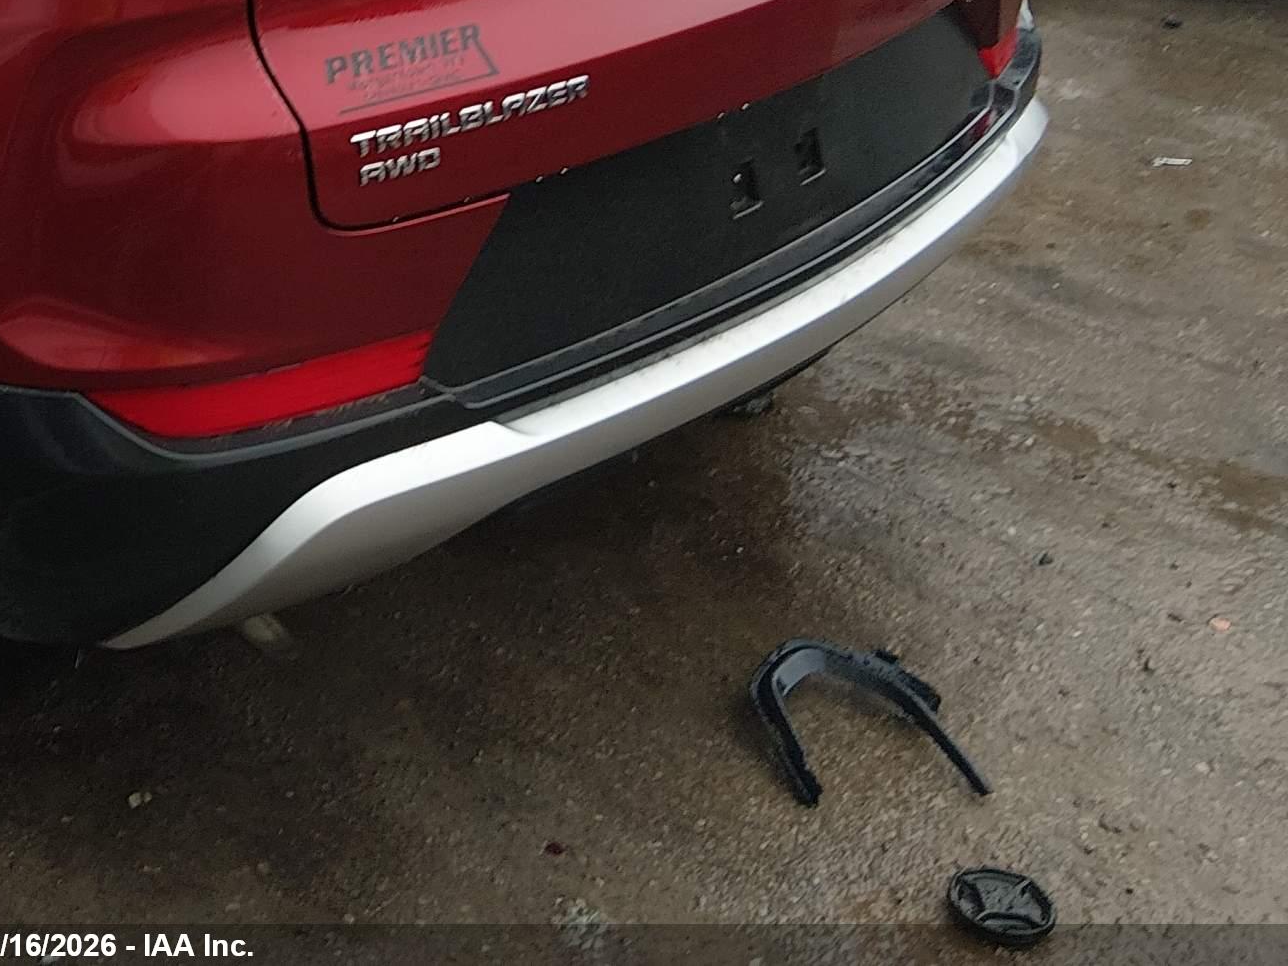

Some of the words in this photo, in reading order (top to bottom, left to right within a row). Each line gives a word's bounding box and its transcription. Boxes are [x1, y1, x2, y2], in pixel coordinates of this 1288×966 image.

[325, 23, 481, 84] PREMIER
[350, 74, 590, 158] TRAILBLAZER
[360, 147, 441, 187] AWD
